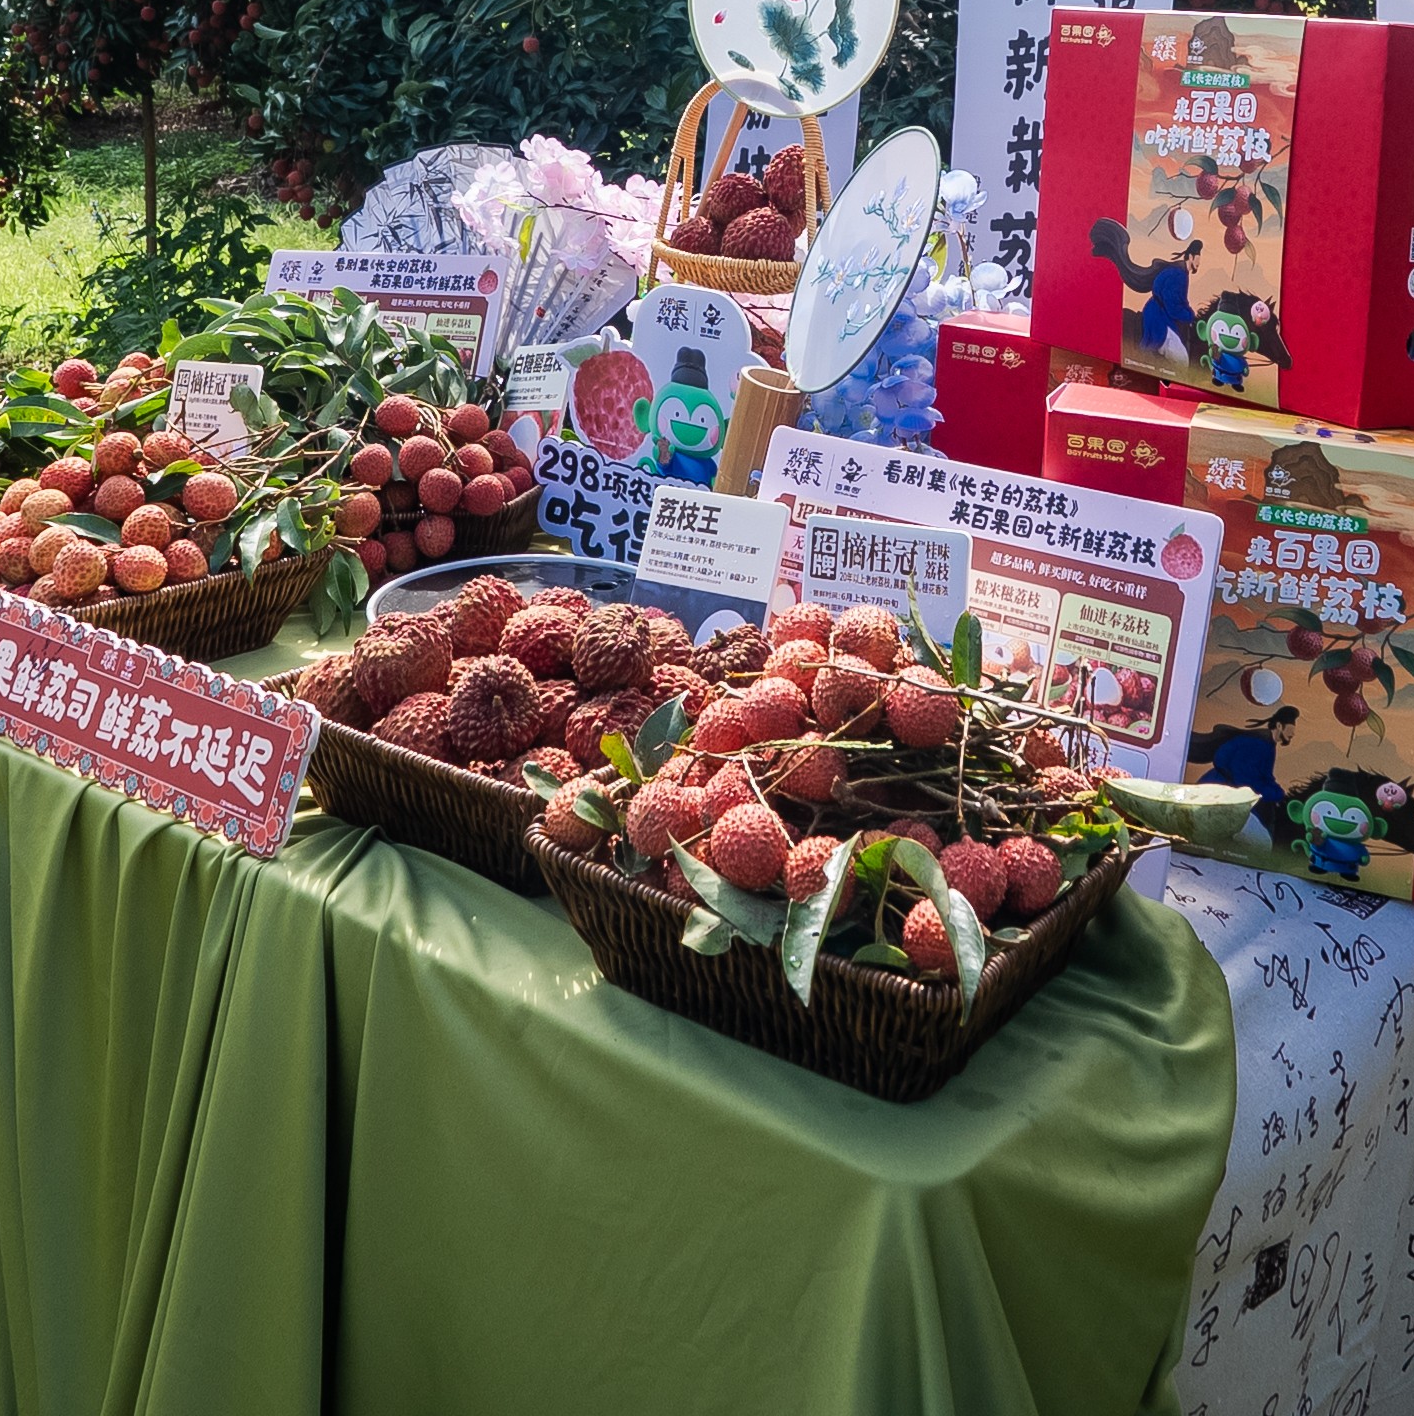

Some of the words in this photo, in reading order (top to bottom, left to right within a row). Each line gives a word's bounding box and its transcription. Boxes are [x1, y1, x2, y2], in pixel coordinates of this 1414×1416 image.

[1173, 90, 1257, 125] 来百果园
[1144, 124, 1272, 167] 吃新鲜荔枝
[369, 274, 476, 292] 来百果园吃新鲜荔枝
[1066, 433, 1126, 454] 百果园
[882, 459, 1080, 519] 看剧集《长安的荔枝》
[655, 497, 722, 535] 荔枝王
[949, 500, 1157, 568] 来百果园吃新鲜荔枝
[1258, 505, 1360, 532] 看《长安的荔枝》
[812, 530, 837, 577] 招牌
[1245, 529, 1381, 575] 来百果园
[974, 578, 1041, 609] 糯米糍荔枝
[1079, 603, 1152, 636] 仙进奉荔枝
[95, 687, 275, 807] 鲜荔不延迟
